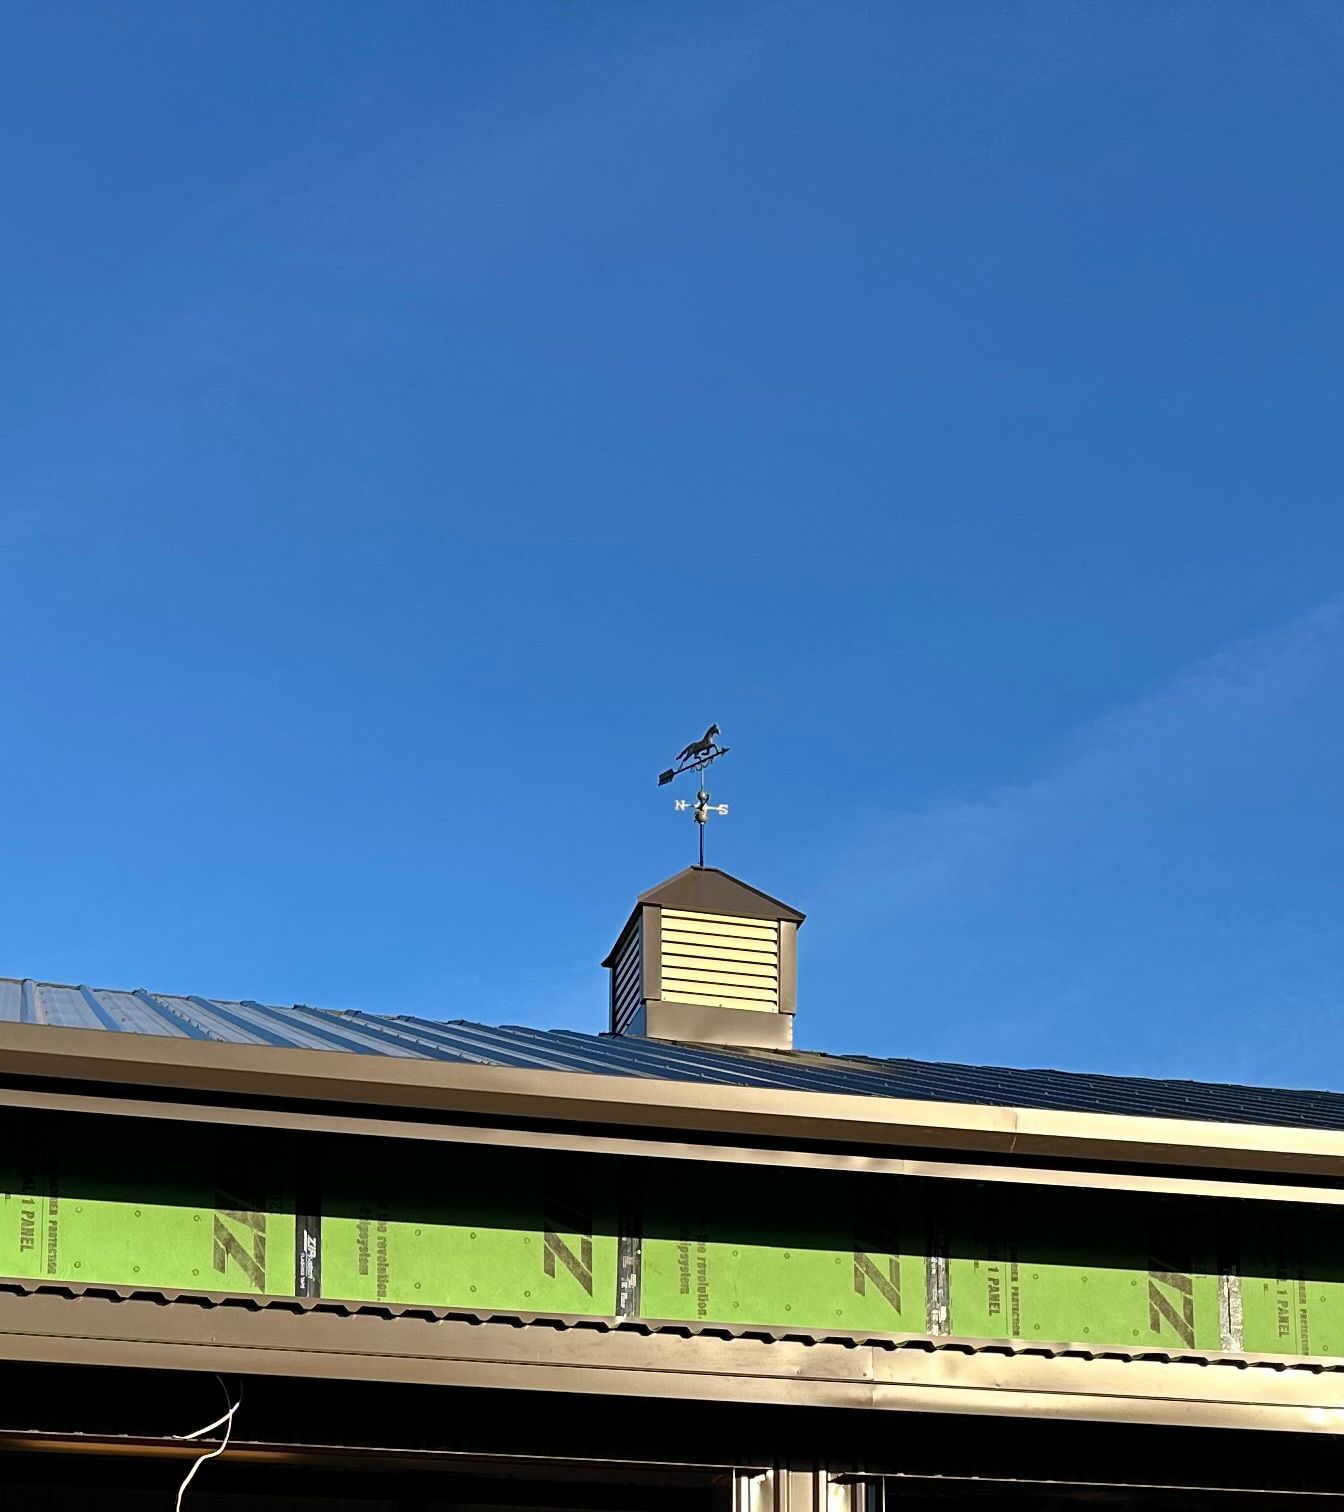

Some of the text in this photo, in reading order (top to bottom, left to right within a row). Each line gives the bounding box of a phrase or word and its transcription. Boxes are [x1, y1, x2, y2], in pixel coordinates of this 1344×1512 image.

[20, 1210, 35, 1253] PANEL
[988, 1277, 1001, 1317] PANEL
[1277, 1300, 1290, 1339] PANEL
